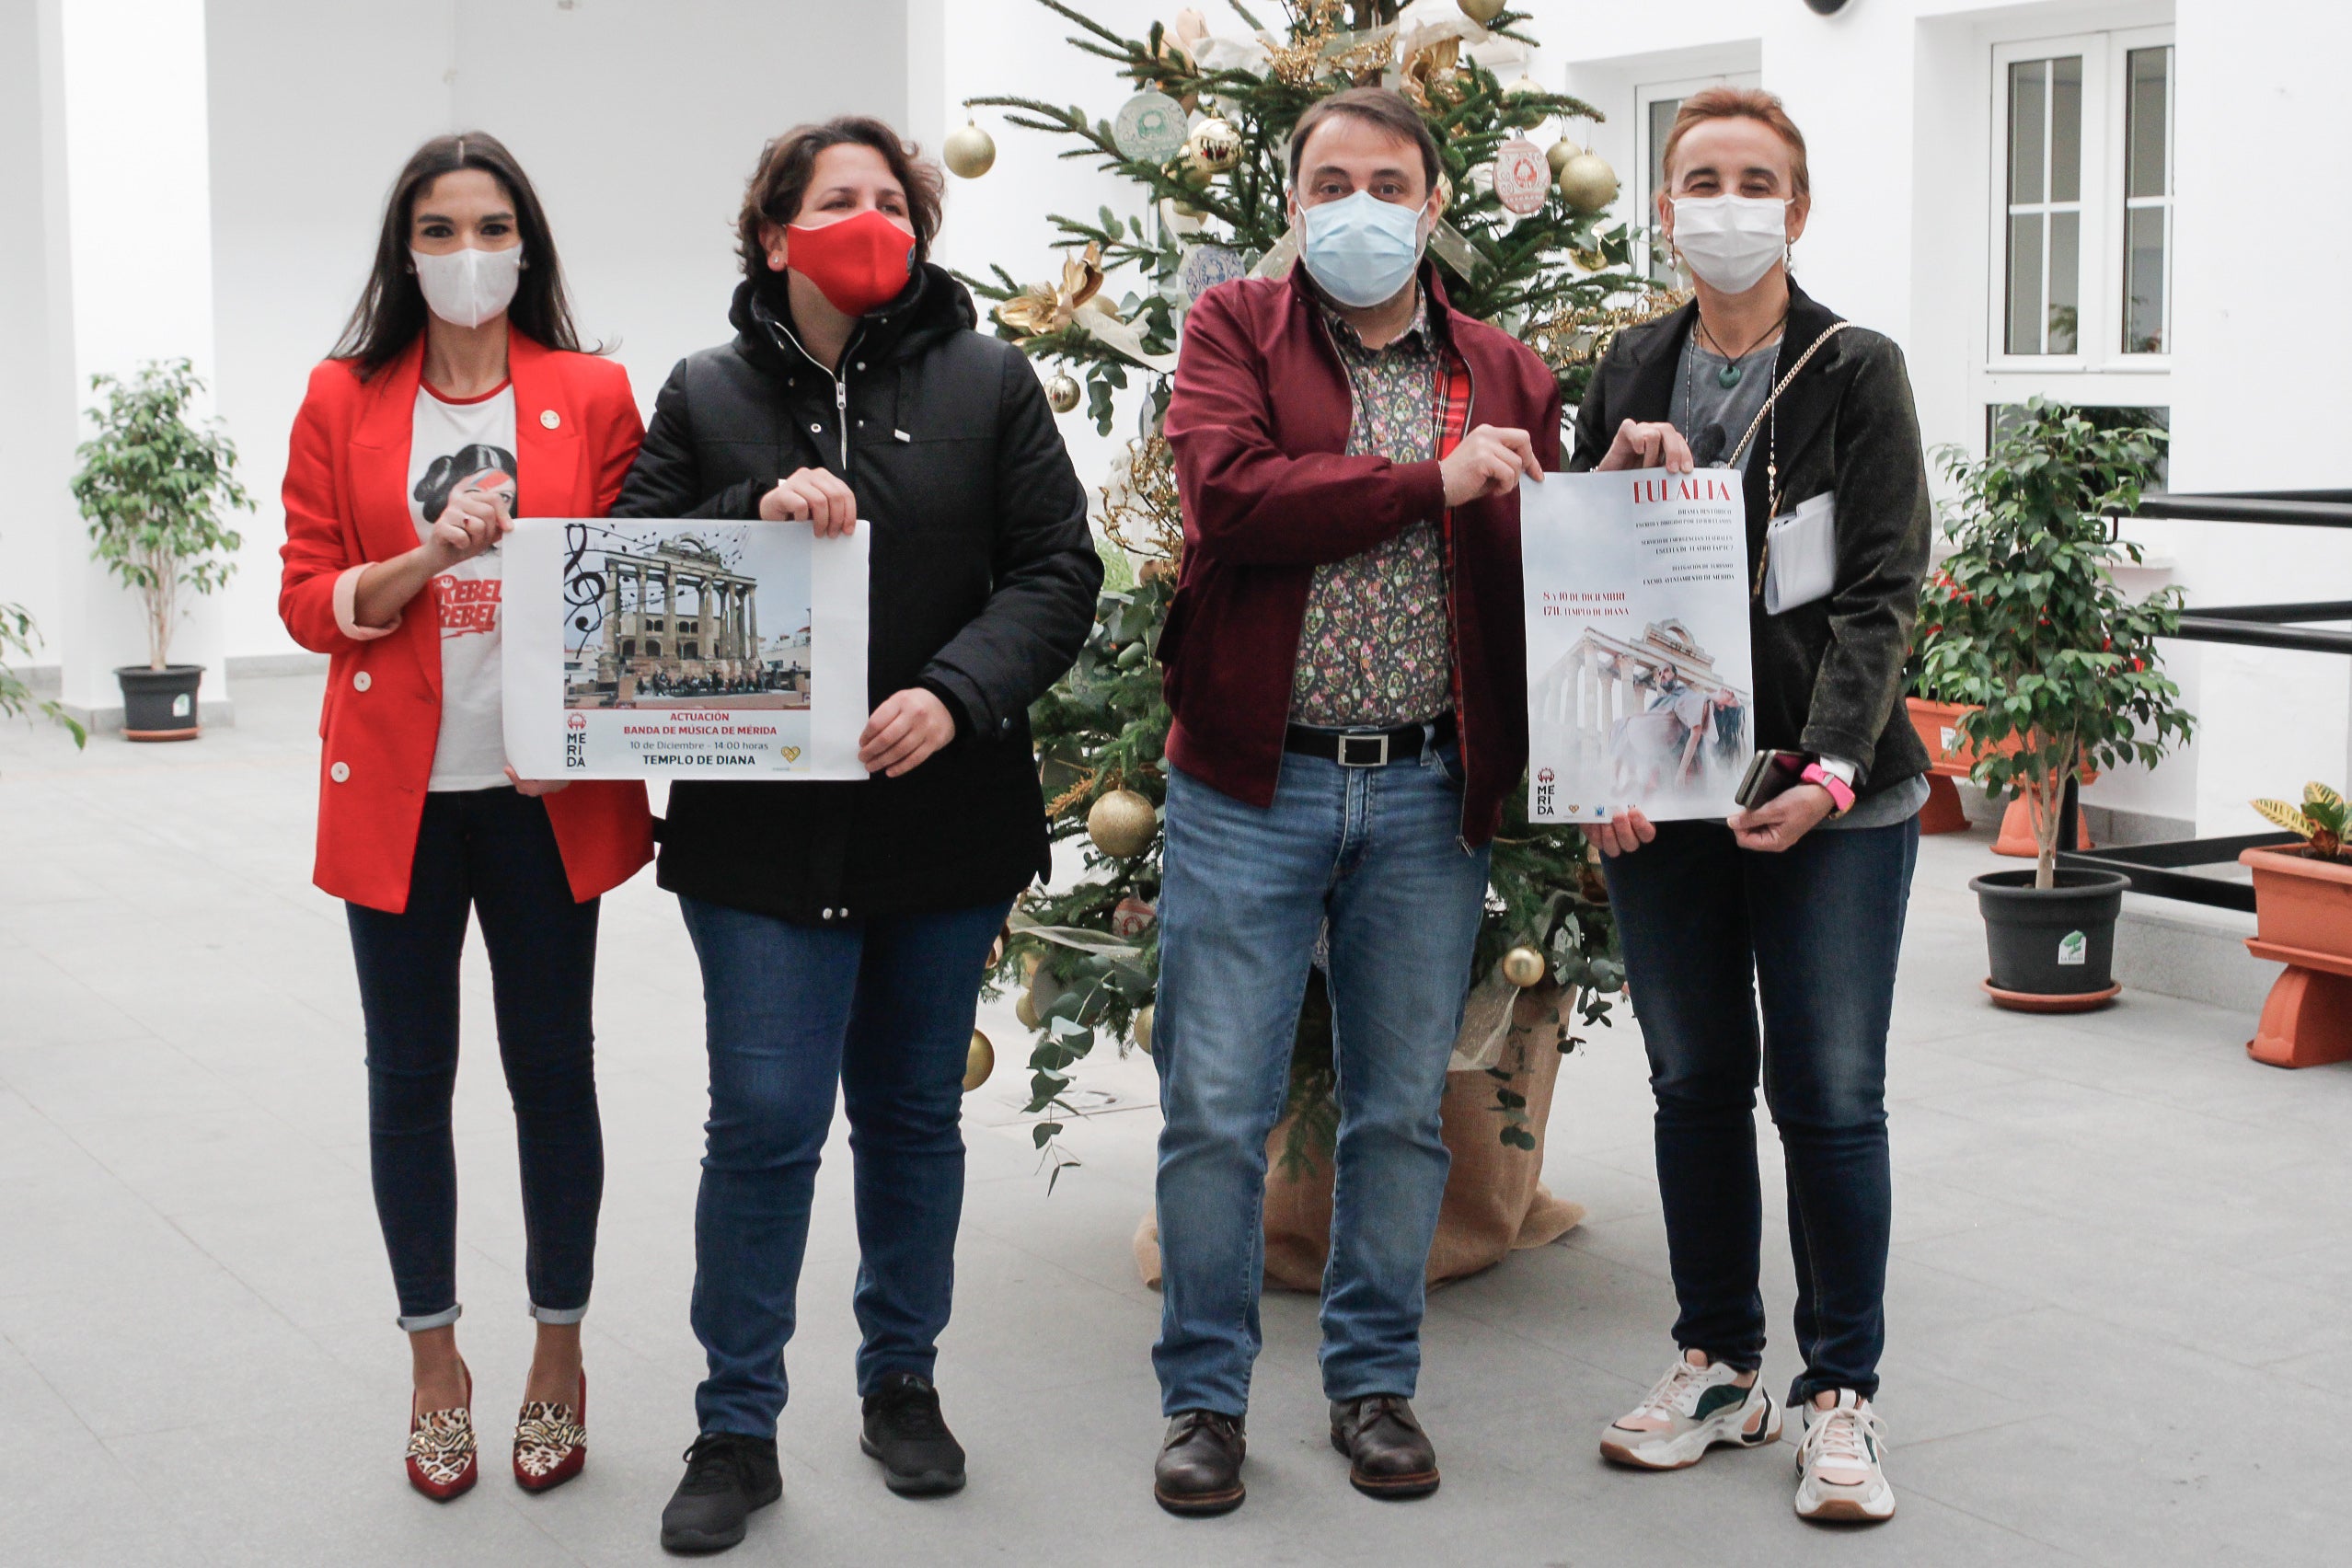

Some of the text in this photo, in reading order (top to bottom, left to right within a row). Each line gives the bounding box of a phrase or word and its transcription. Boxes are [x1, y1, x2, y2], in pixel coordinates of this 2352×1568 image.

[1634, 478, 1730, 504] EULALIA
[1543, 592, 1550, 600] 8
[1604, 607, 1629, 616] DIANA
[670, 711, 729, 721] ACTUACIÓN
[624, 724, 777, 735] BANDA DE MÚSICA DE MÉRIDA
[567, 732, 586, 744] ME
[567, 745, 582, 755] RI
[630, 741, 640, 749] 10
[643, 741, 654, 749] de
[657, 741, 705, 750] Diciembre
[743, 742, 768, 750] horas
[567, 756, 585, 767] DA
[642, 755, 755, 765] TEMPLO DE DIANA
[1538, 785, 1554, 795] ME
[1538, 796, 1551, 805] RI
[1538, 806, 1554, 815] DA
